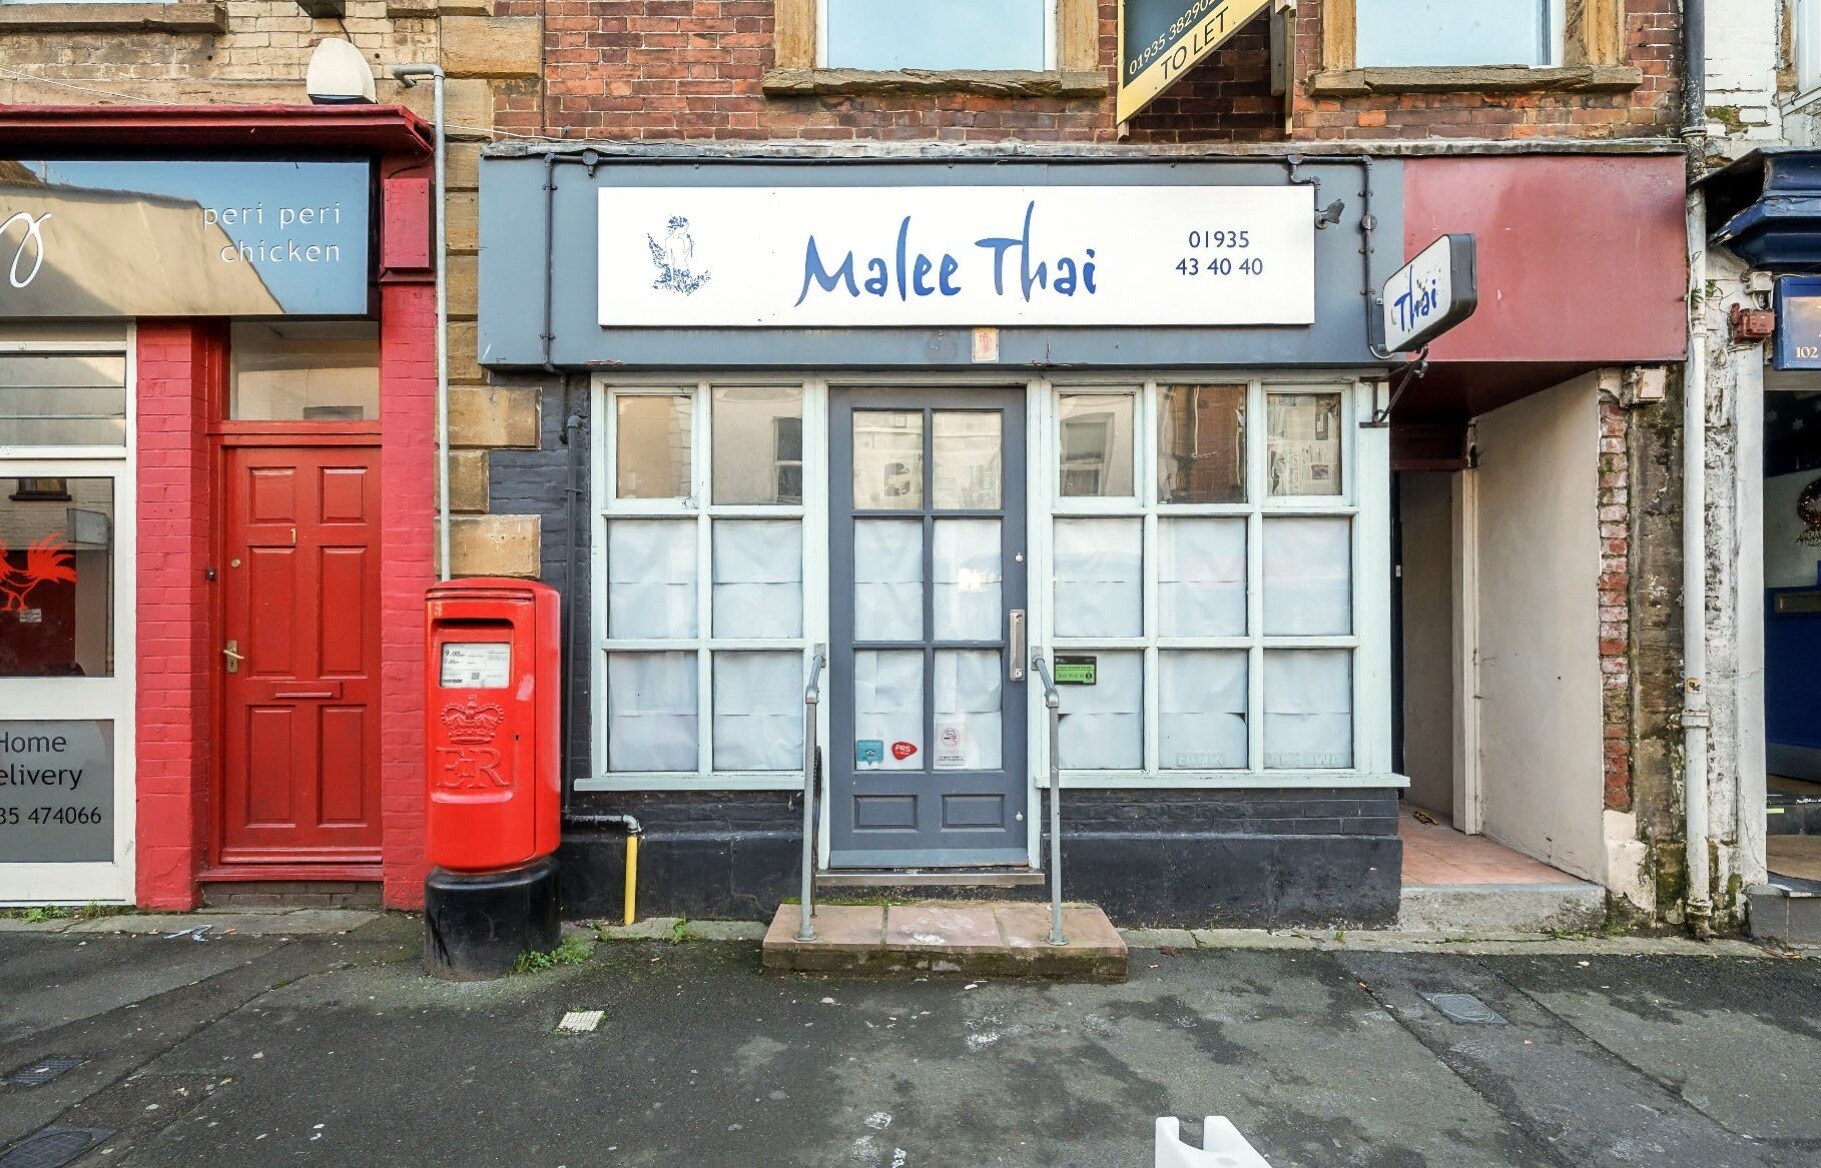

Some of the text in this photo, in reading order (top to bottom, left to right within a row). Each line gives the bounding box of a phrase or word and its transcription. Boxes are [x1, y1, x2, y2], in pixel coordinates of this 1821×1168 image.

[1129, 0, 1215, 75] 01935 38290
[1161, 6, 1229, 80] TO LET
[203, 201, 341, 231] peri peri
[220, 239, 340, 263] chicken
[1188, 230, 1250, 248] 01935
[793, 200, 1097, 308] Malee Thai
[1175, 257, 1264, 276] 43 40 40
[1393, 263, 1437, 332] Thai
[1795, 346, 1819, 359] 102
[27, 806, 102, 825] 474066
